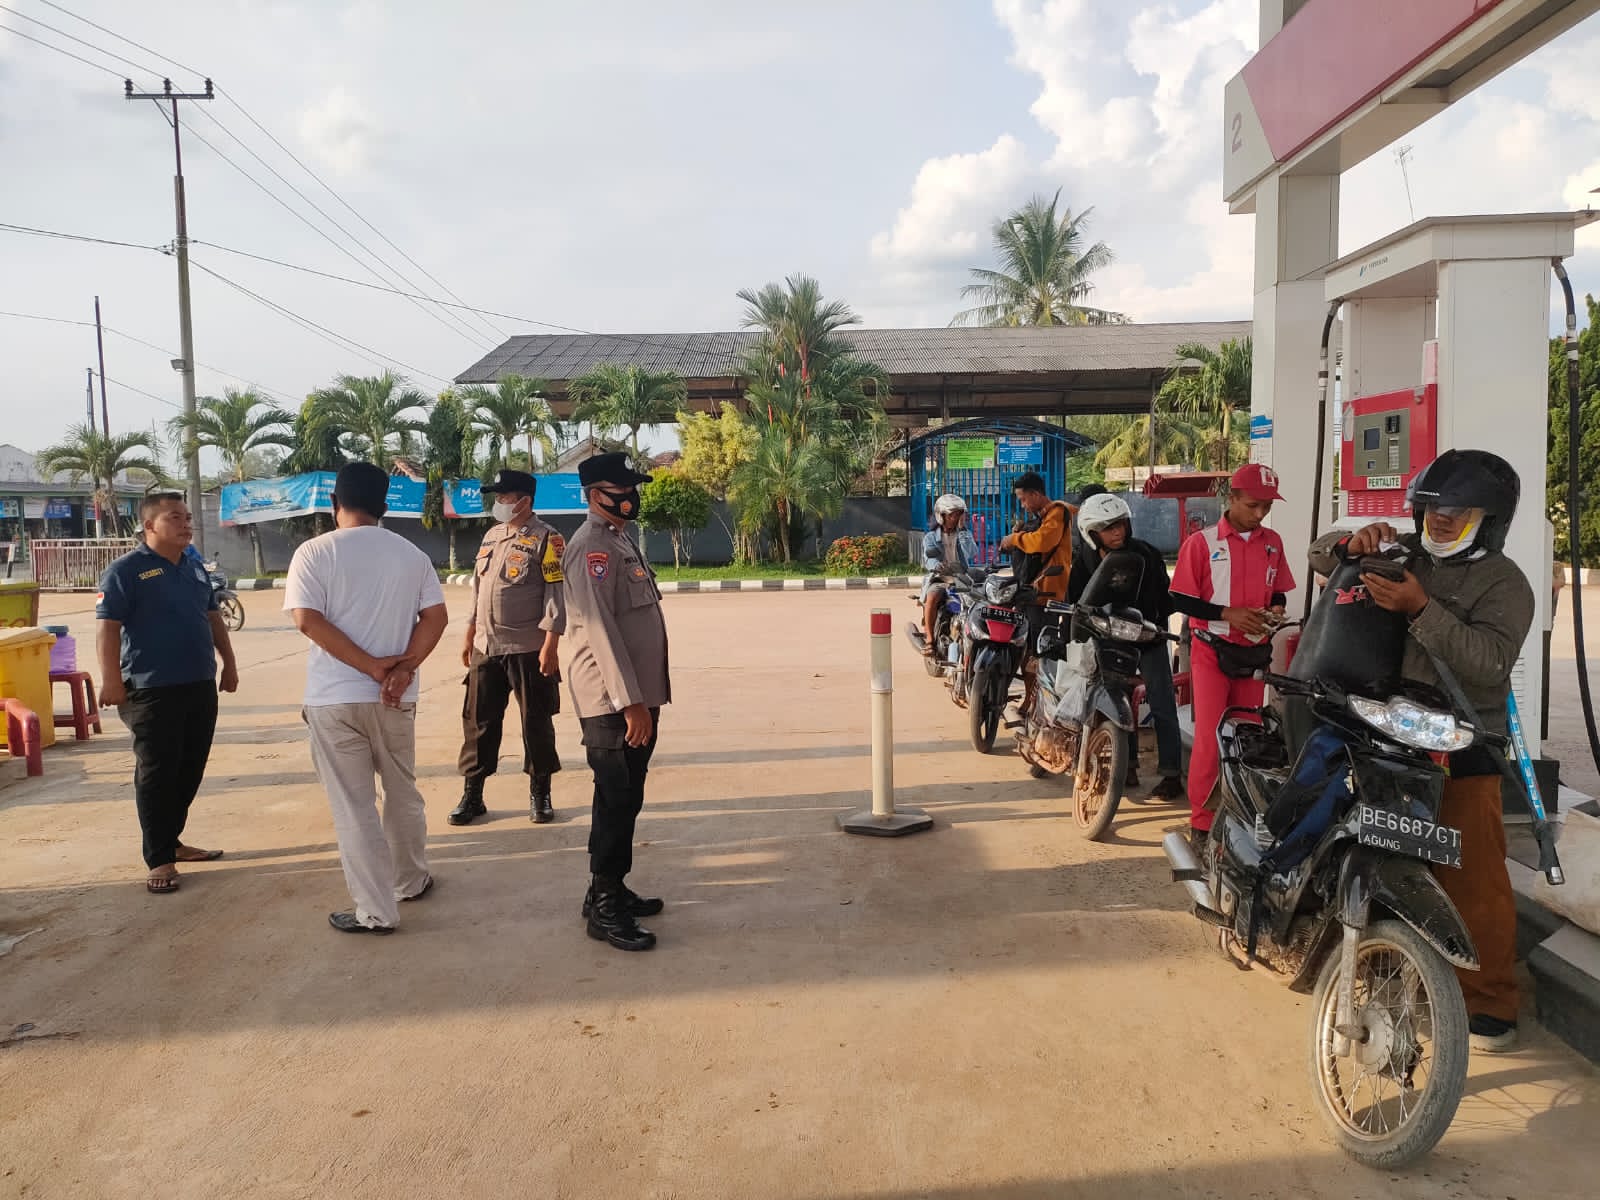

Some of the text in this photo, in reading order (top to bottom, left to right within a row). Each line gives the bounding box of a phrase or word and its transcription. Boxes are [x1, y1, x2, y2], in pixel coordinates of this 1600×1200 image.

[1231, 111, 1242, 154] 2
[1367, 477, 1400, 488] PERTALITE
[1363, 834, 1401, 850] AGUNG
